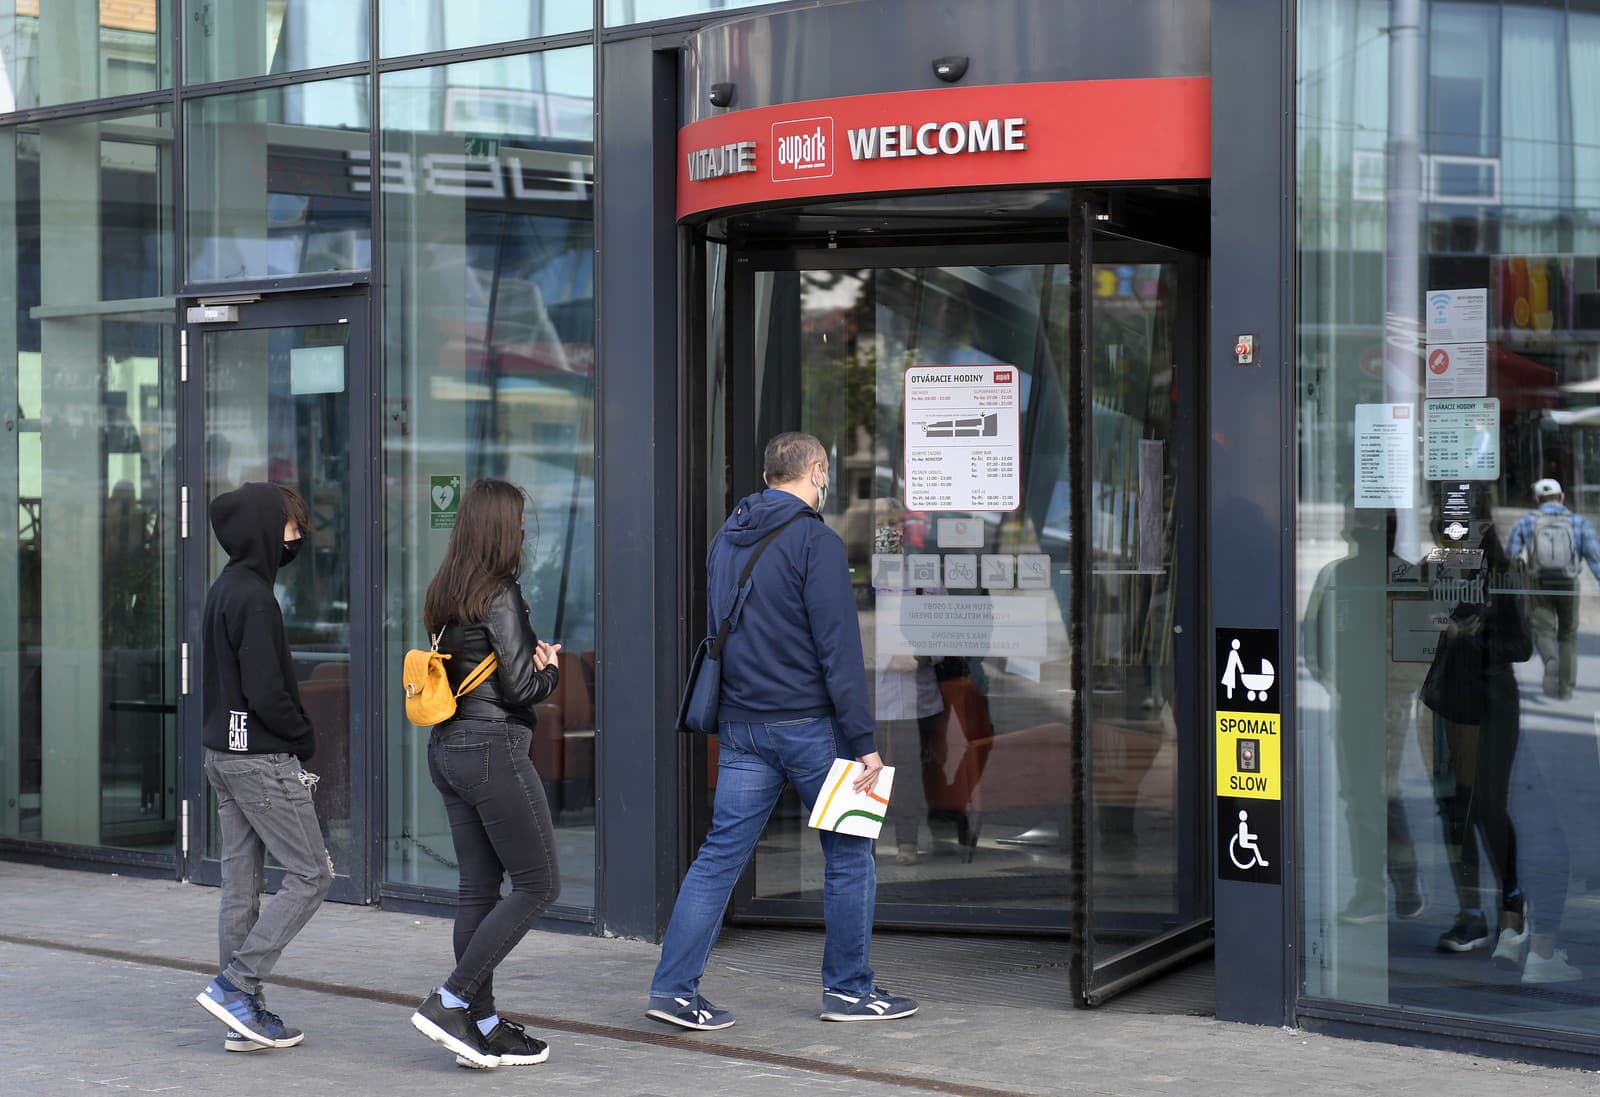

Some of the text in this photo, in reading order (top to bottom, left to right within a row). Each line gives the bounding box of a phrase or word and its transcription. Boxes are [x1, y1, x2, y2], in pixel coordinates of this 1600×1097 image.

[688, 117, 1027, 182] VITAJTE aupark WELCOME
[911, 373, 984, 384] OTVÁRACIE HODINY
[230, 714, 248, 731] ALE
[1220, 718, 1277, 735] SPOMAĽ
[229, 731, 248, 748] CAU
[1230, 775, 1267, 792] SLOW
